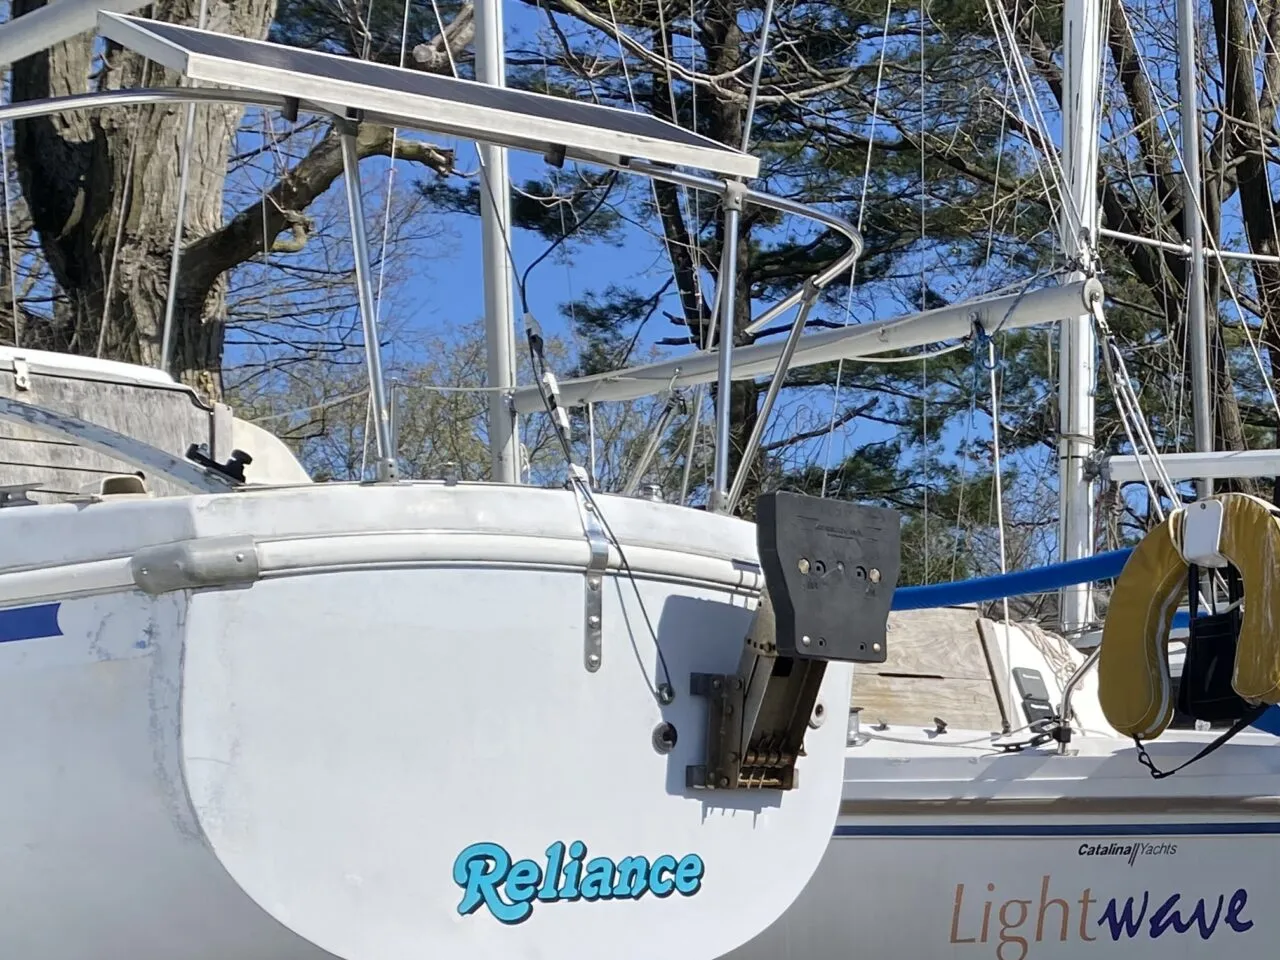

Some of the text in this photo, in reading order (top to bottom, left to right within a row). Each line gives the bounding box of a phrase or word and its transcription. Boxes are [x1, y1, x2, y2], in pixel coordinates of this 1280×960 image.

[1078, 843, 1178, 856] Catalina Yachts
[453, 840, 705, 925] Reliance
